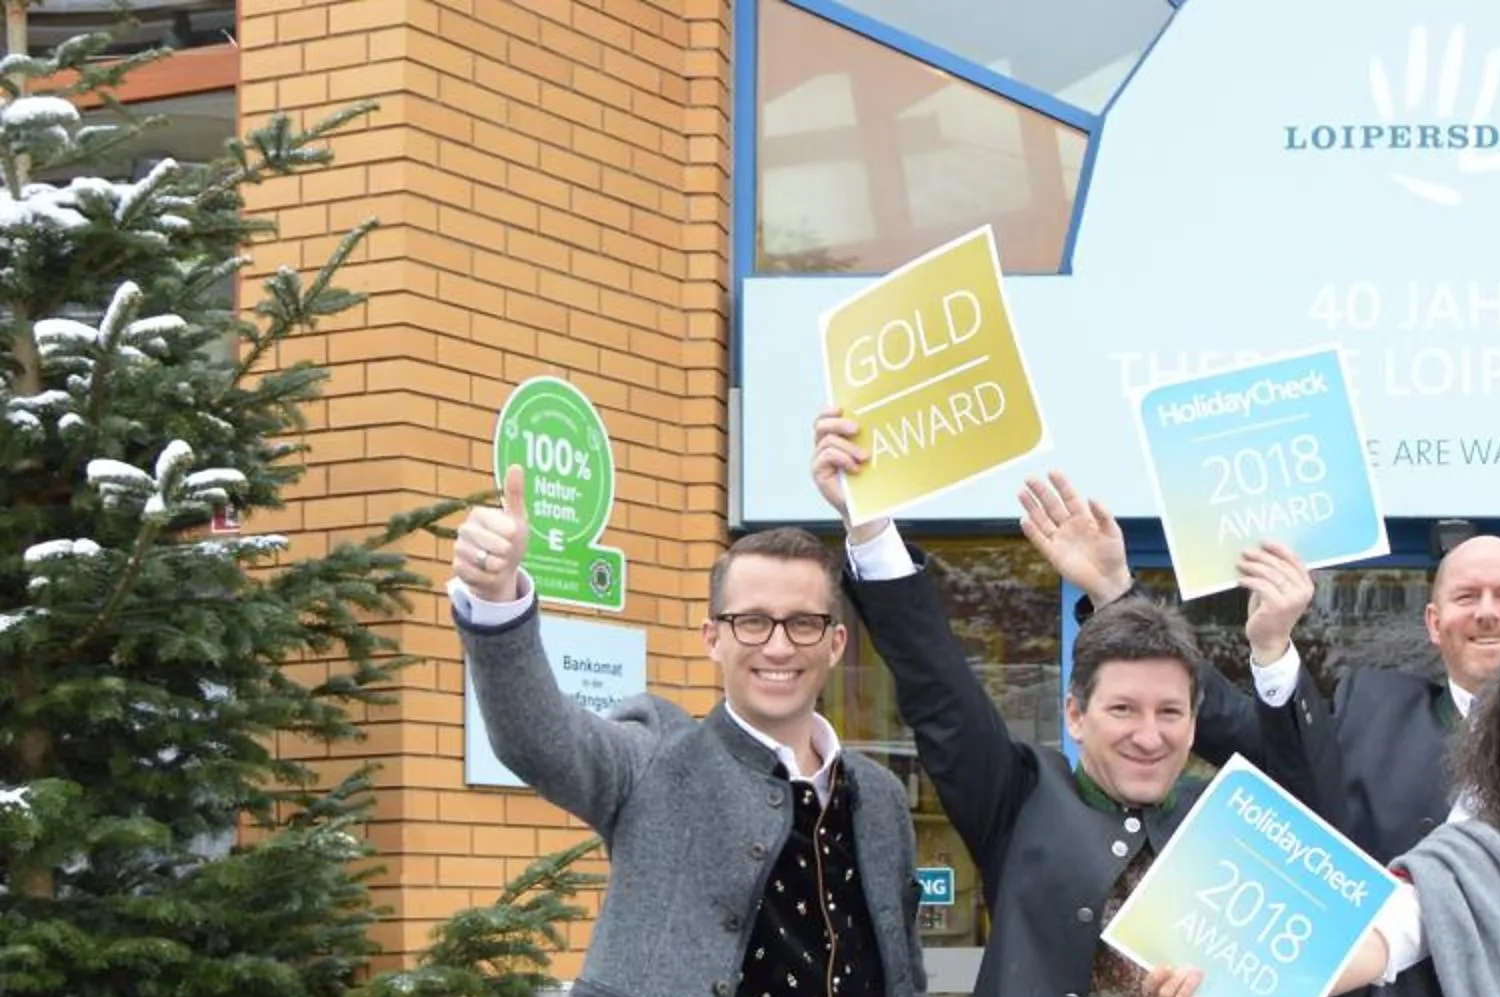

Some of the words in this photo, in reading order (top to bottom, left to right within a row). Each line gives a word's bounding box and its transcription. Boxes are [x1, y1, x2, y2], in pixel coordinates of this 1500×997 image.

[1306, 281, 1382, 332] 40
[843, 289, 983, 387] GOLD
[871, 381, 1006, 467] AWARD
[1155, 369, 1329, 428] HolidayCheck
[522, 430, 592, 480] 100%
[1202, 433, 1326, 505] 2018
[1393, 438, 1451, 466] ARE
[533, 501, 580, 524] strom.
[534, 475, 582, 501] Natur-
[1217, 491, 1336, 544] AWARD
[563, 654, 623, 678] Bankomat
[1228, 786, 1369, 908] HolidayCheck
[1196, 859, 1312, 963] 2018
[1173, 910, 1280, 997] AWARD
